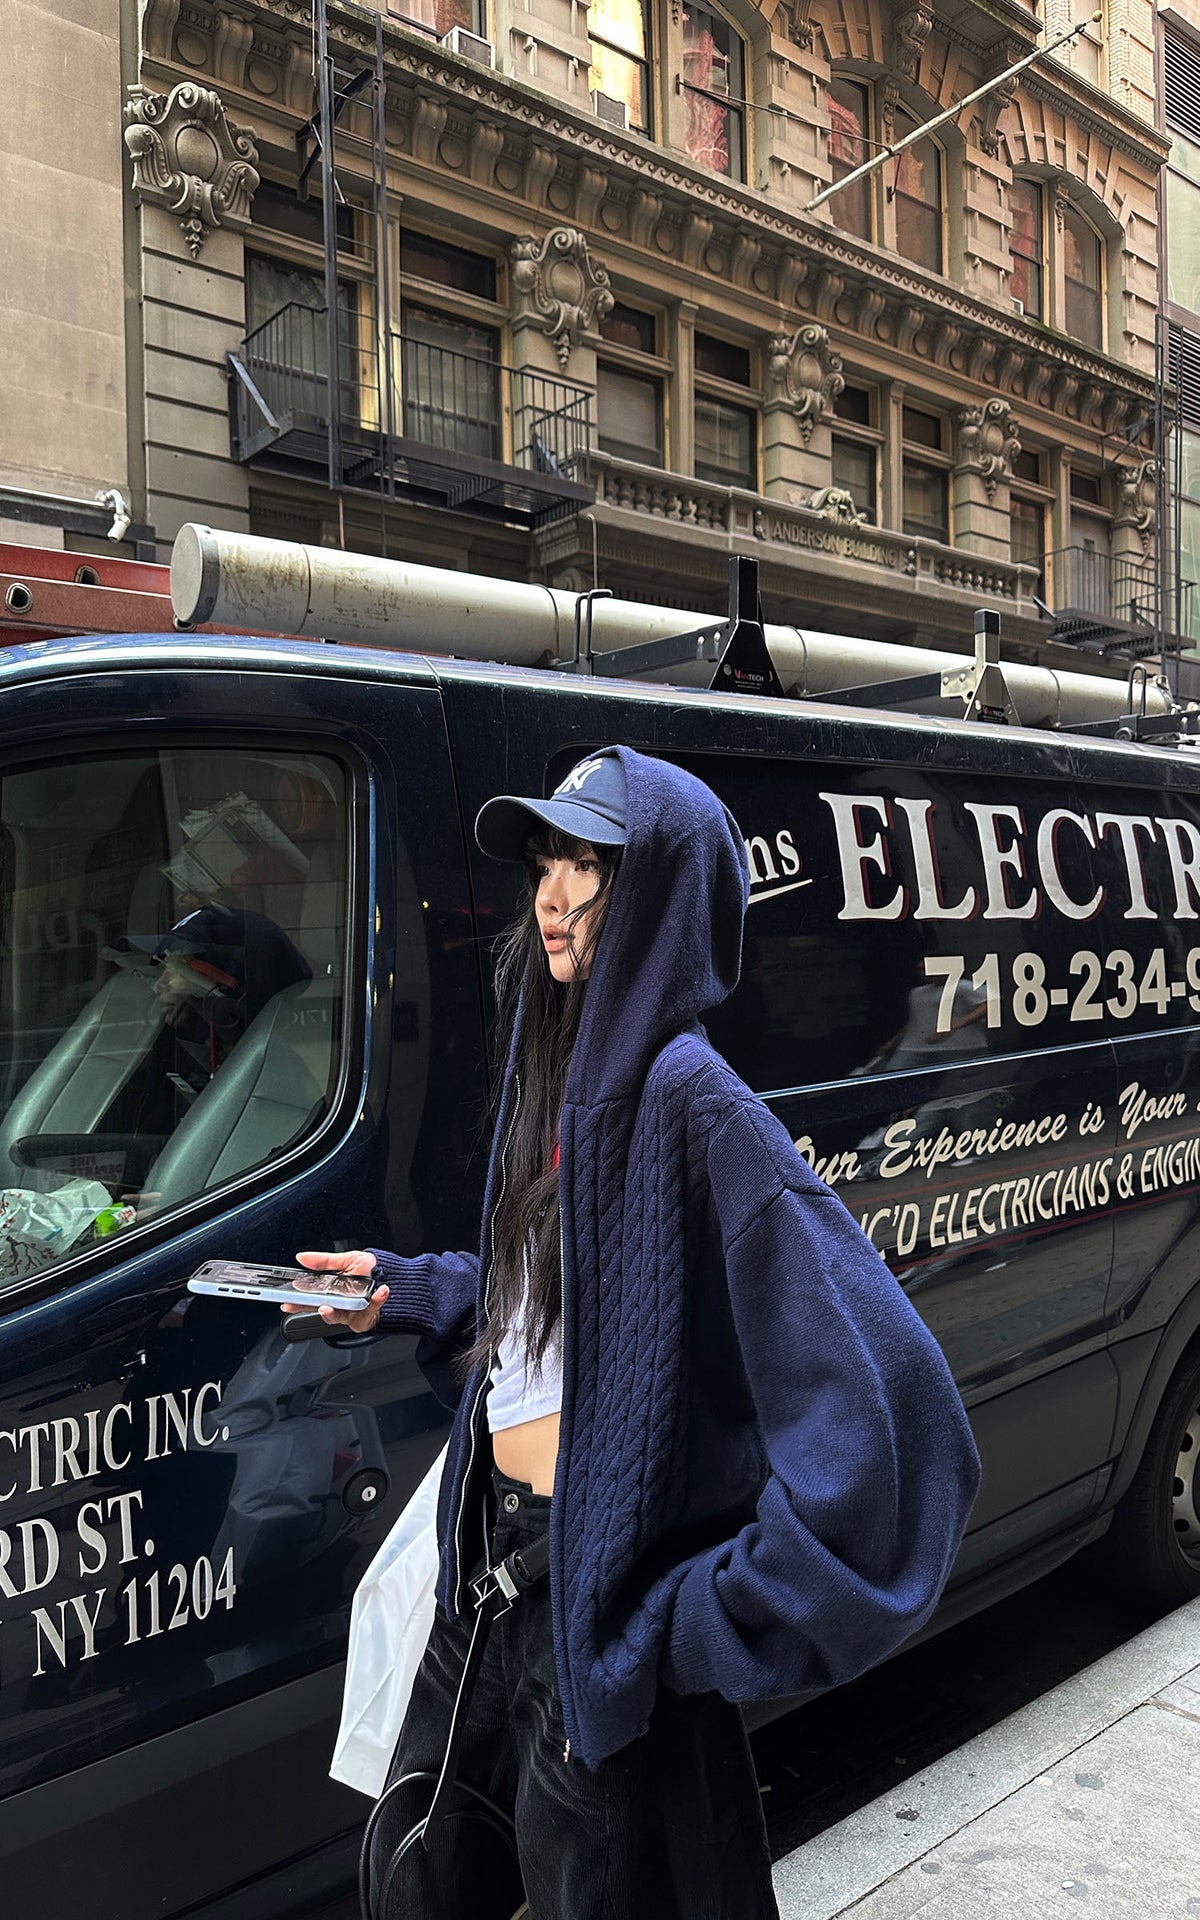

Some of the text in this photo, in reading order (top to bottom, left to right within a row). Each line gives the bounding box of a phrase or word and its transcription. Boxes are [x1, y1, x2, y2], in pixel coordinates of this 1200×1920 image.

[772, 521, 896, 567] ANDERSON BUILDING
[819, 792, 1200, 920] ELECTR
[879, 1113, 1068, 1179] Experience
[1078, 1102, 1105, 1136] is
[1118, 1081, 1187, 1139] Your
[929, 1157, 1113, 1248] ELECTRICIANS
[1116, 1152, 1135, 1199] &
[144, 1380, 230, 1461] INC.
[77, 1490, 155, 1578] ST.
[31, 1546, 237, 1677] NY 11204
